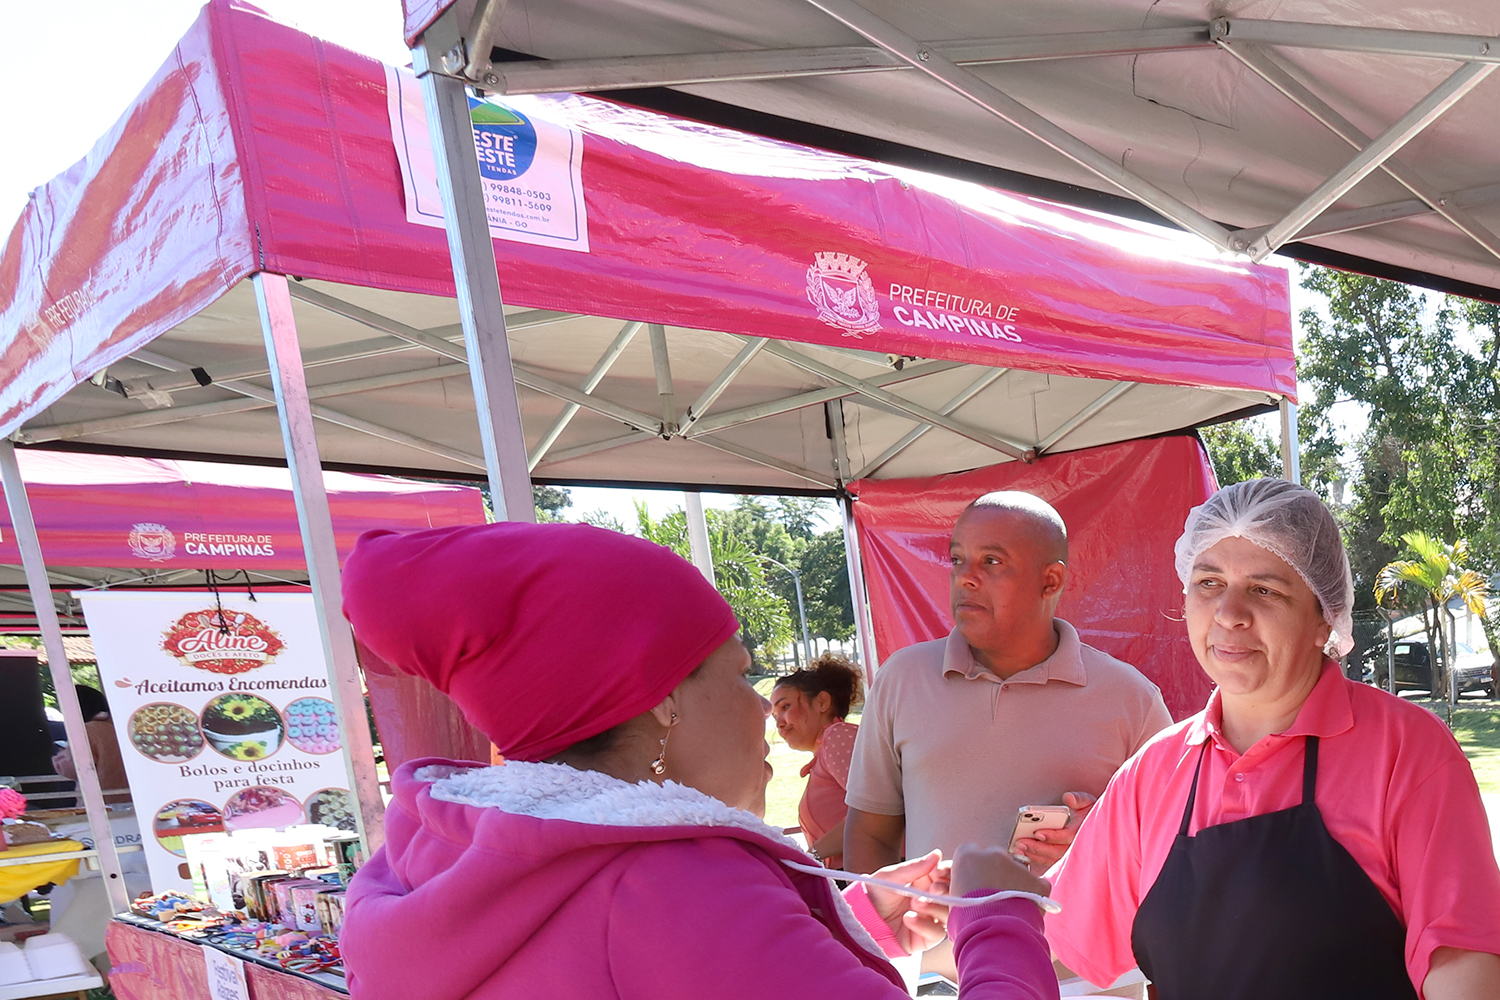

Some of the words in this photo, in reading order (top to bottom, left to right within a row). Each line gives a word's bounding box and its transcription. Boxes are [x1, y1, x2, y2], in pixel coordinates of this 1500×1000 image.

[486, 164, 517, 176] TENDAS
[490, 182, 551, 201] 99848-0503
[492, 194, 552, 212] 99811-5609
[889, 283, 992, 318] PREFEITURA
[995, 305, 1020, 322] DE
[892, 306, 1023, 343] CAMPINAS
[184, 532, 255, 544] PREFEITURA
[257, 535, 272, 544] DE
[185, 542, 275, 556] CAMPINAS
[180, 628, 267, 651] Aline
[192, 652, 223, 660] DOCES
[231, 651, 260, 659] AFETO
[134, 679, 224, 695] Aceitamos
[228, 677, 327, 692] Encomendas
[179, 763, 228, 778] Bolos
[233, 764, 242, 774] e
[247, 759, 321, 774] docinhos
[213, 778, 250, 793] para
[255, 773, 296, 789] festa
